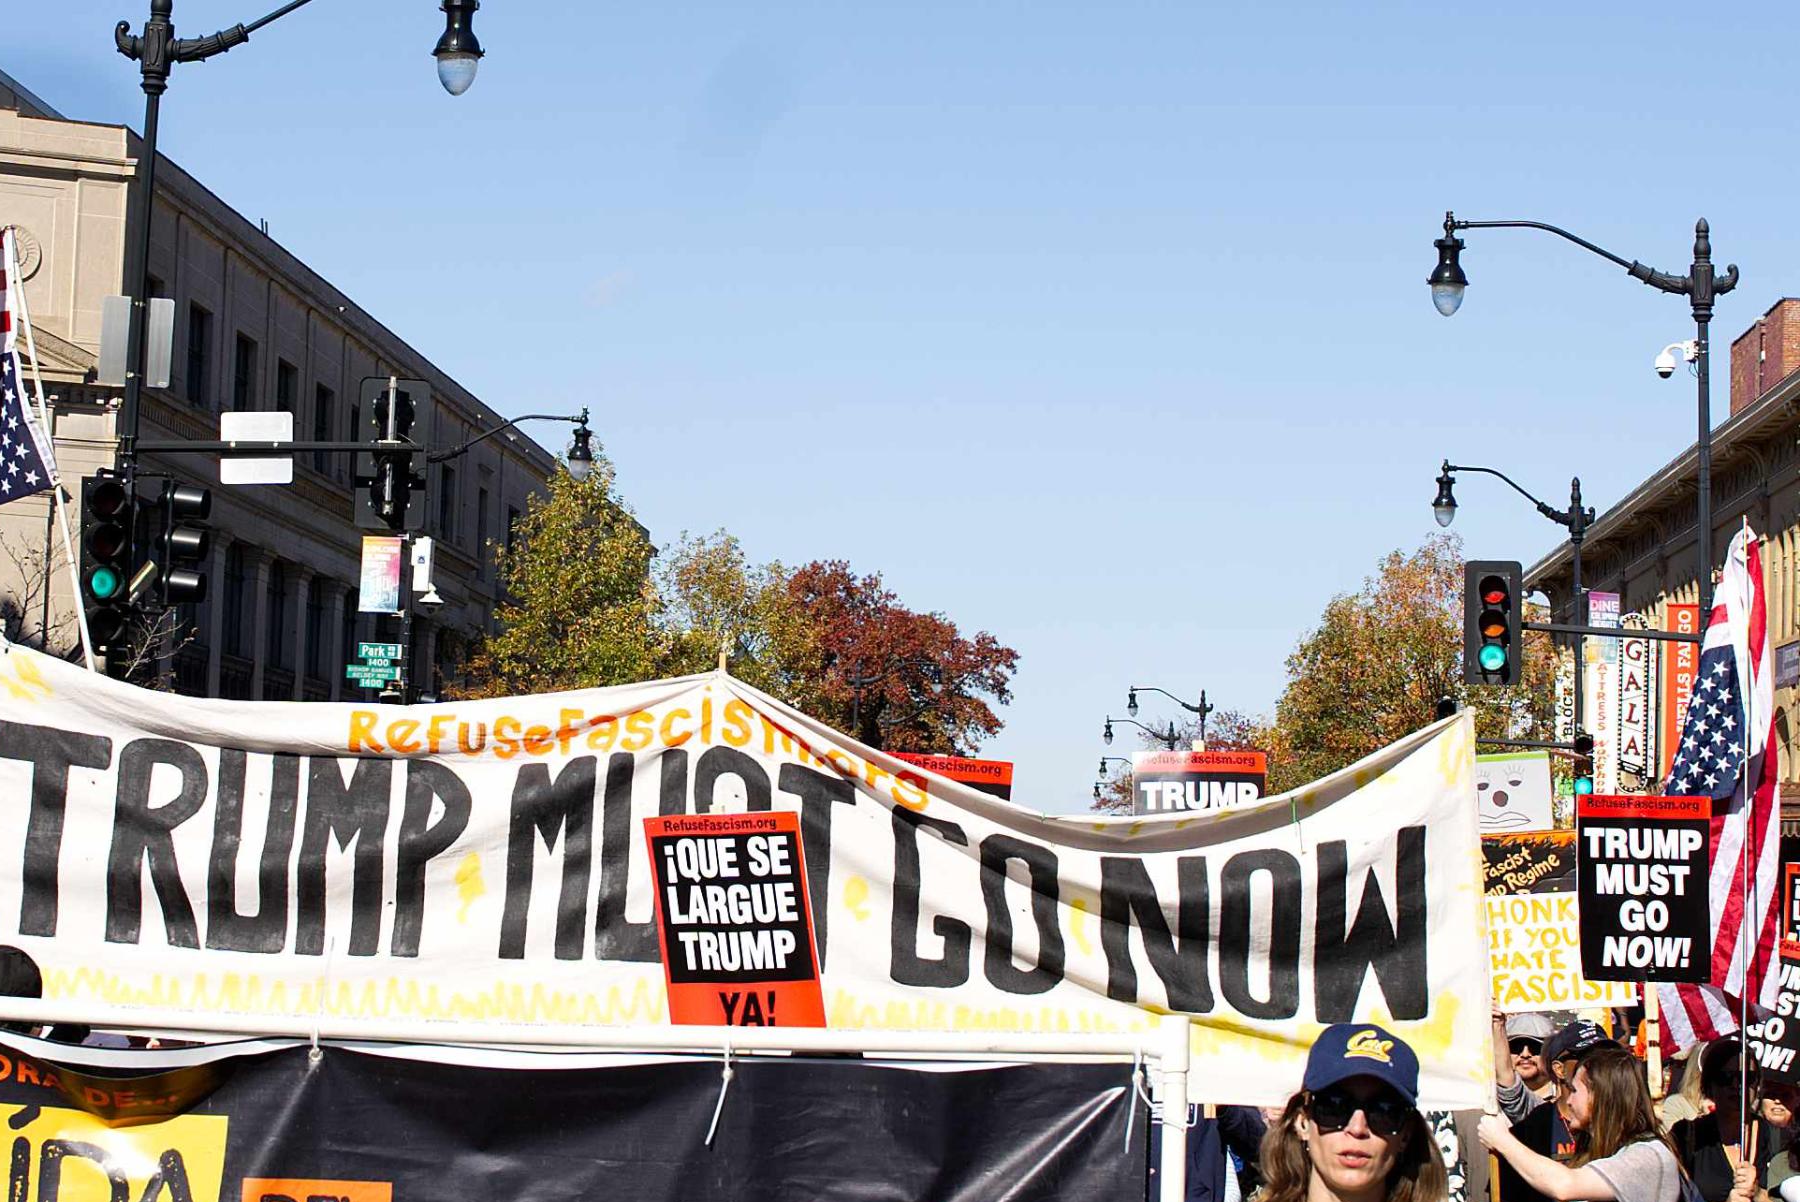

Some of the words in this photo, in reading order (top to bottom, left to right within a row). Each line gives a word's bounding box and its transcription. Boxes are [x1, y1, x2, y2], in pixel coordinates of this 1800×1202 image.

[1591, 600, 1620, 613] DINE
[362, 644, 385, 657] Park
[1676, 610, 1693, 669] FAGO
[1596, 663, 1608, 731] ATTRESS
[1624, 639, 1643, 756] GALA
[1139, 780, 1260, 811] TRUMP
[1586, 797, 1700, 812] RefuseFascism.org
[663, 817, 777, 832] RefuseFascism.org
[663, 837, 741, 884] ¡QUE
[746, 835, 793, 877] SE
[1583, 826, 1703, 861] TRUMP
[497, 745, 858, 975] MUT
[890, 803, 1065, 995] GO
[1099, 825, 1428, 1022] NOW
[1503, 853, 1561, 891] Regime
[1595, 863, 1691, 897] MUST
[666, 882, 799, 925] LARGUE
[1487, 896, 1577, 926] HONK
[1618, 899, 1669, 932] GO
[678, 929, 797, 972] TRUMP
[1490, 929, 1513, 950] IF
[1525, 927, 1578, 949] YOU
[1602, 935, 1692, 968] NOW!
[1491, 949, 1565, 971] HATE
[718, 990, 777, 1027] YA!
[1344, 1029, 1395, 1062] Cal
[1746, 1038, 1797, 1074] OW!
